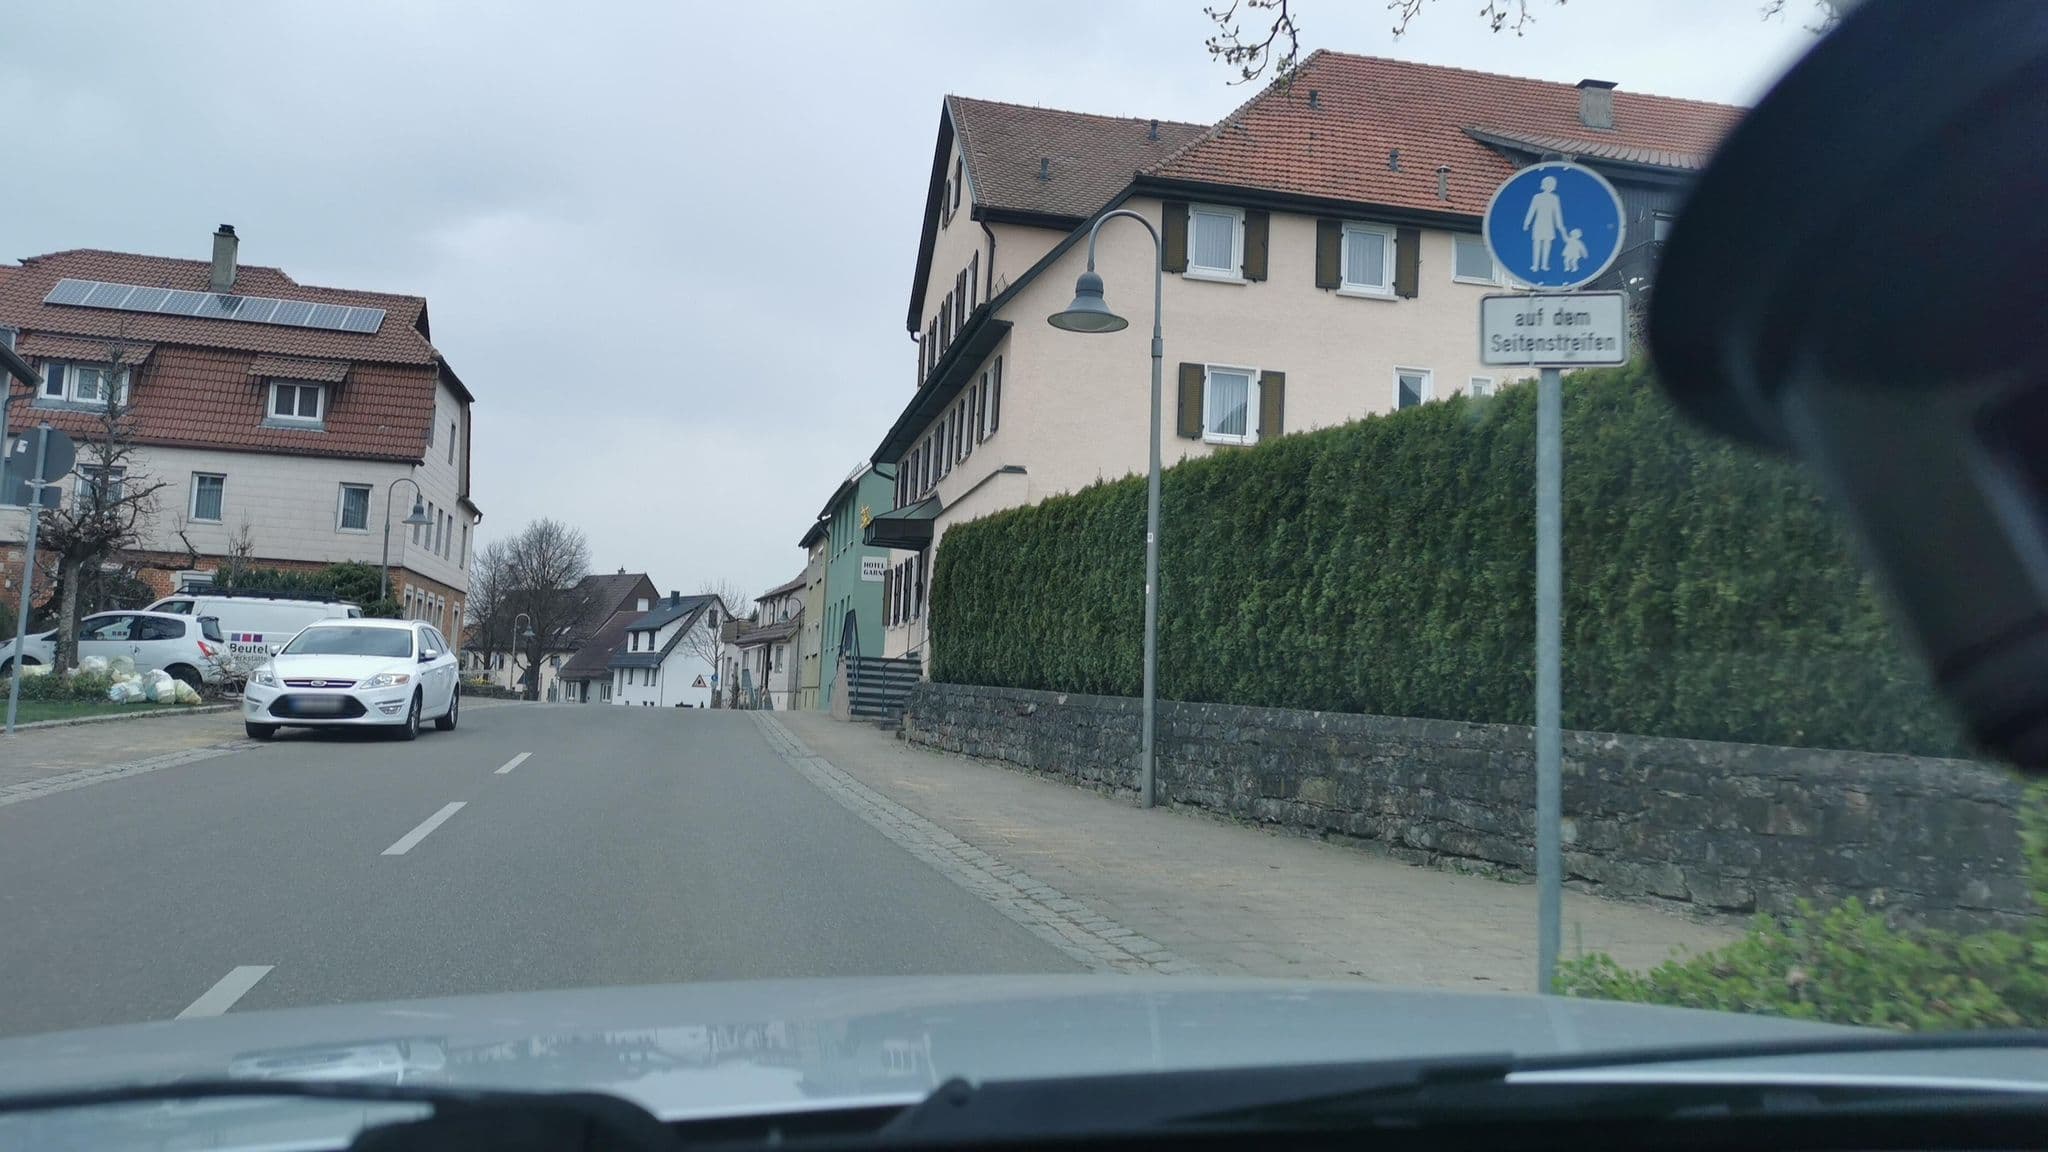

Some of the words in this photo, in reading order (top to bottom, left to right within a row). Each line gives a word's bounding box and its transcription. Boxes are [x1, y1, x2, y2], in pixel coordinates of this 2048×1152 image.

[1514, 307, 1544, 327] auf
[1552, 307, 1591, 326] dem
[1491, 332, 1616, 352] Seitenstreifen
[230, 643, 268, 654] Beutel
